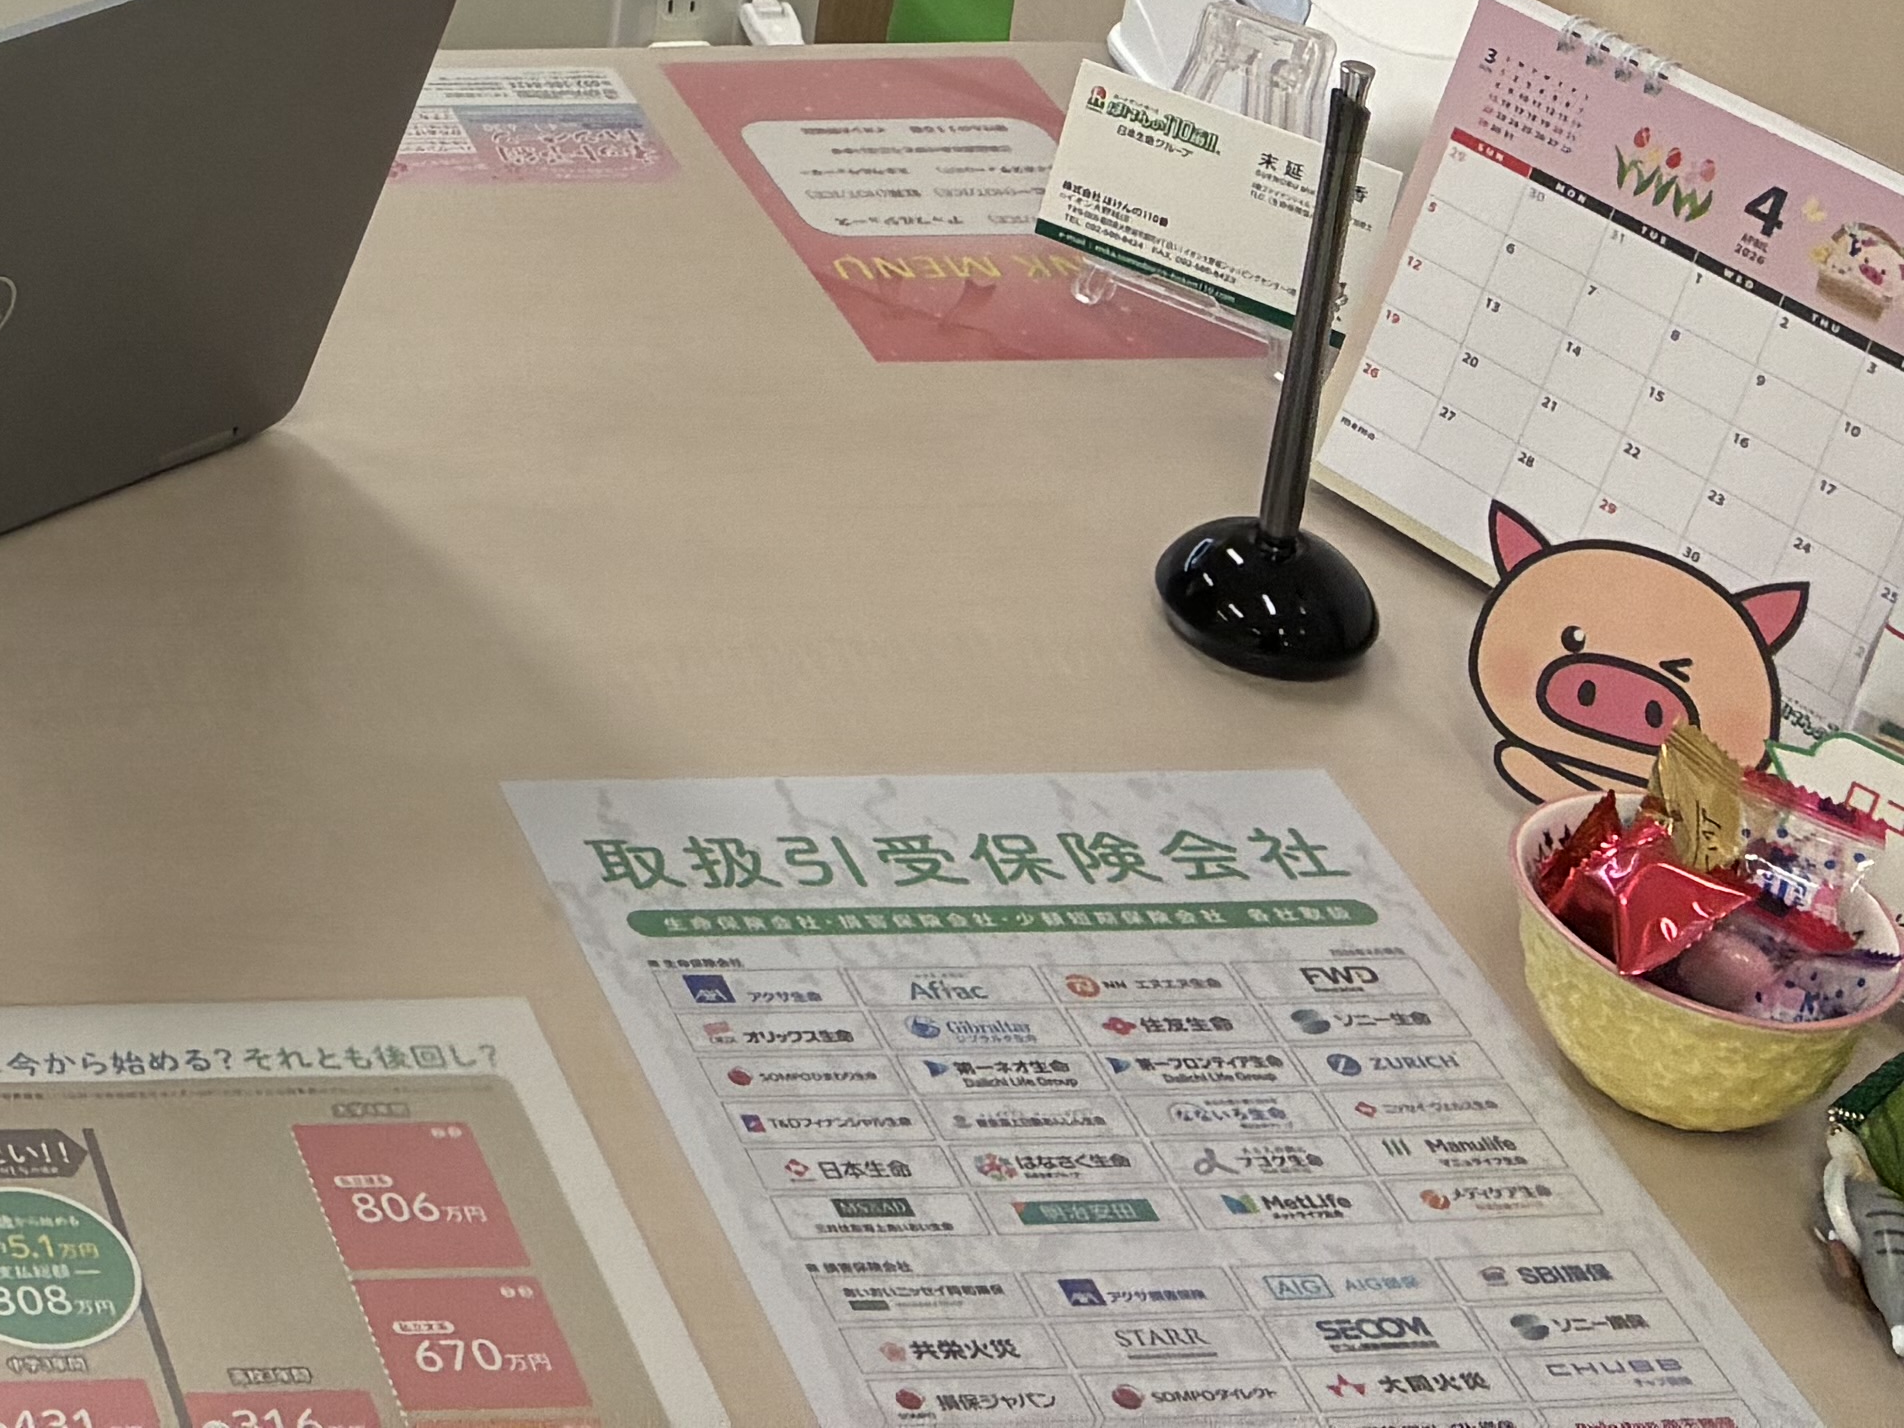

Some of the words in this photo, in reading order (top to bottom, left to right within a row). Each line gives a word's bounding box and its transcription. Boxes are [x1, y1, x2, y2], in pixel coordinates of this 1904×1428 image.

[1483, 47, 1498, 64] 3
[1743, 185, 1789, 238] 4
[1740, 233, 1770, 254] APRIL
[832, 254, 1002, 280] MENU
[1555, 181, 1588, 205] MON
[1812, 312, 1841, 335] THU
[1734, 246, 1767, 267] 2026
[1528, 187, 1546, 205] 30
[1778, 317, 1789, 330] 2
[1866, 360, 1877, 375] 3
[1427, 200, 1438, 214] 5
[1505, 242, 1516, 256] 6
[1586, 285, 1598, 297] 7
[1669, 329, 1680, 343] 8
[1755, 374, 1767, 388] 9
[1843, 419, 1862, 438] 10
[1405, 255, 1423, 273] 12
[1485, 297, 1501, 315] 13
[1565, 341, 1582, 359] 14
[1647, 385, 1665, 404] 15
[1732, 430, 1750, 450] 16
[1819, 478, 1837, 496] 17
[1340, 414, 1378, 443] memo
[1361, 362, 1380, 379] 26
[1438, 404, 1457, 422] 27
[1516, 451, 1535, 469] 28
[1598, 497, 1617, 515] 29
[1682, 546, 1700, 564] 30
[1385, 308, 1400, 326] 19
[1461, 351, 1479, 370] 20
[1541, 395, 1558, 413] 21
[1622, 441, 1641, 460] 22
[1706, 487, 1726, 507] 23
[1792, 536, 1812, 556] 24
[1880, 585, 1900, 605] 25
[584, 827, 1352, 890] 取扱引受保険会社
[1299, 965, 1380, 987] FWD
[910, 979, 989, 1001] Aflac
[945, 1019, 1032, 1034] Gibraltar
[1139, 1015, 1234, 1034] 住友生命
[1335, 1010, 1433, 1028] ソニー生命
[741, 1029, 855, 1045] オリックス生命
[953, 1058, 1071, 1076] 第一ネオ生命
[1369, 1053, 1459, 1071] ZURICH
[1424, 1136, 1518, 1154] Manulife
[818, 1159, 913, 1181] 日本生命
[1015, 1153, 1132, 1170] はなさく生命
[351, 1191, 488, 1224] 806万円
[1039, 1201, 1135, 1220] 明治安田
[1260, 1194, 1353, 1211] MetLife
[1515, 1263, 1615, 1285] SBI損保
[1274, 1278, 1322, 1297] AIG
[1113, 1328, 1211, 1348] STARR
[1315, 1316, 1434, 1340] SECOM
[415, 1337, 553, 1373] 670万円
[909, 1338, 1022, 1361] 共栄火災
[1546, 1359, 1682, 1378] CHUBB
[936, 1391, 1057, 1412] 損保ジャパン
